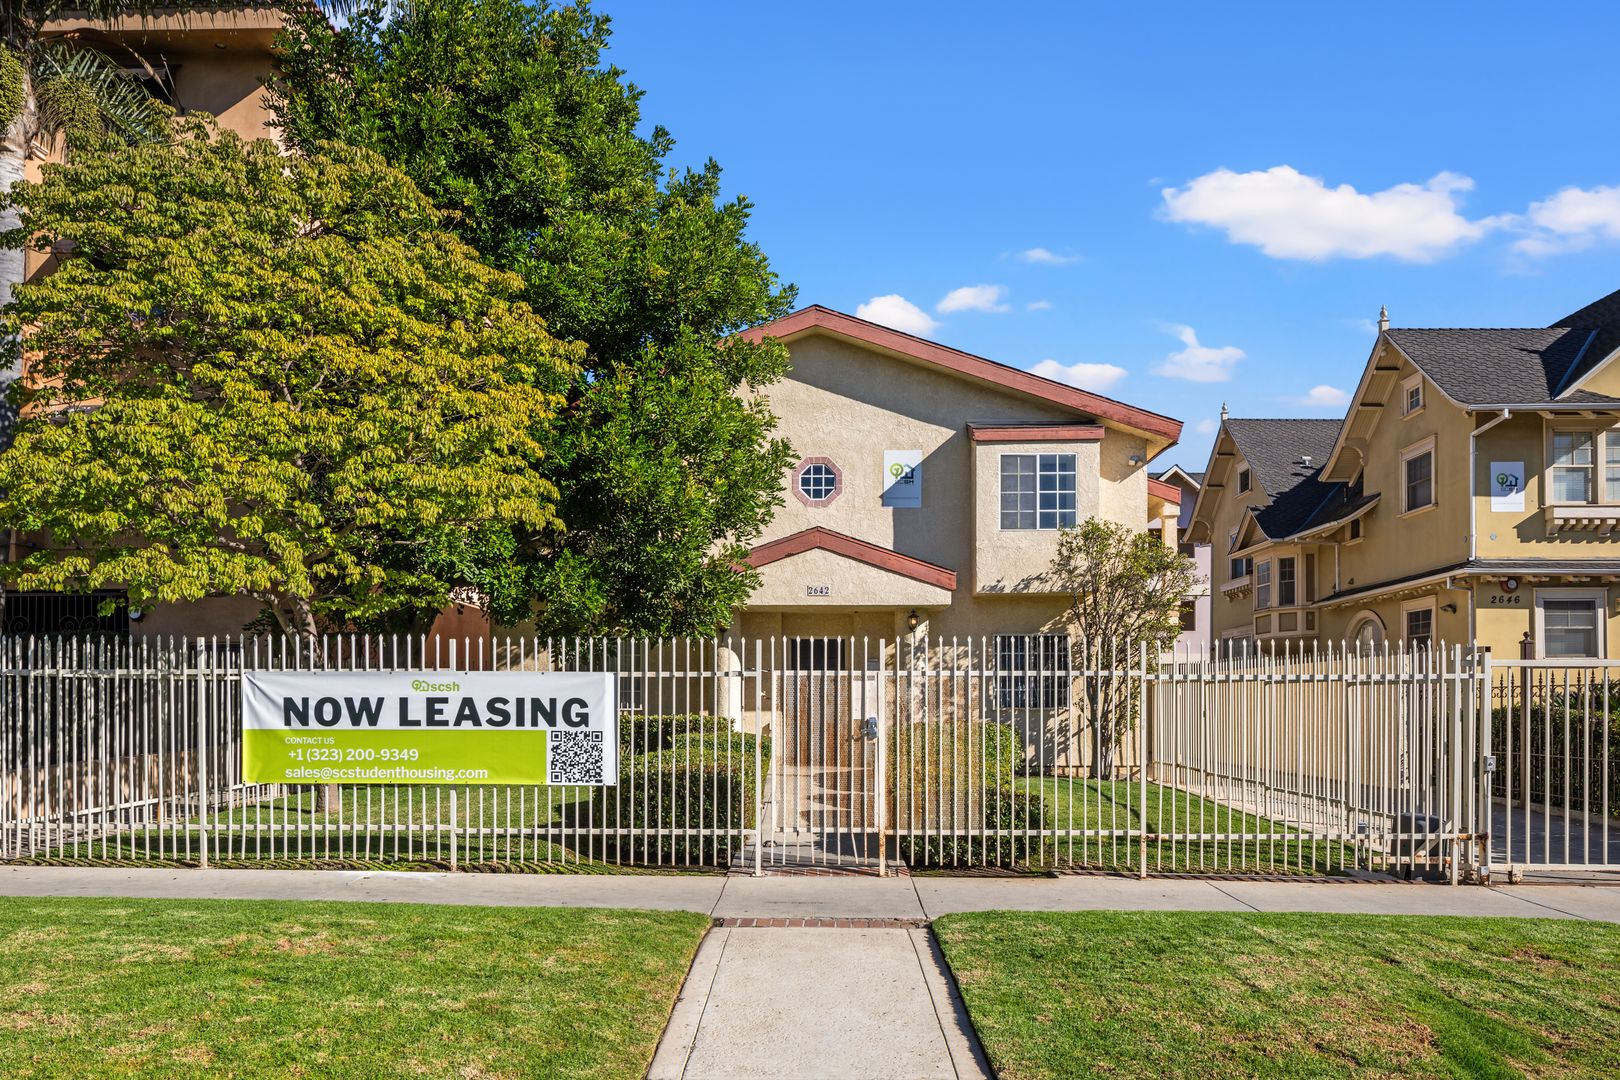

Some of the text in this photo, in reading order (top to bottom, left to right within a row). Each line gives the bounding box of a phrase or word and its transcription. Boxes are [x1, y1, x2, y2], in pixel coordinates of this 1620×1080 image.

[808, 585, 830, 595] 2642
[1491, 596, 1520, 604] 2646
[430, 681, 460, 692] scsh
[283, 697, 589, 727] NOW LEASING
[288, 749, 419, 762] +1 (323) 200-9349
[285, 767, 488, 780] sales@scstudenthousing.com
